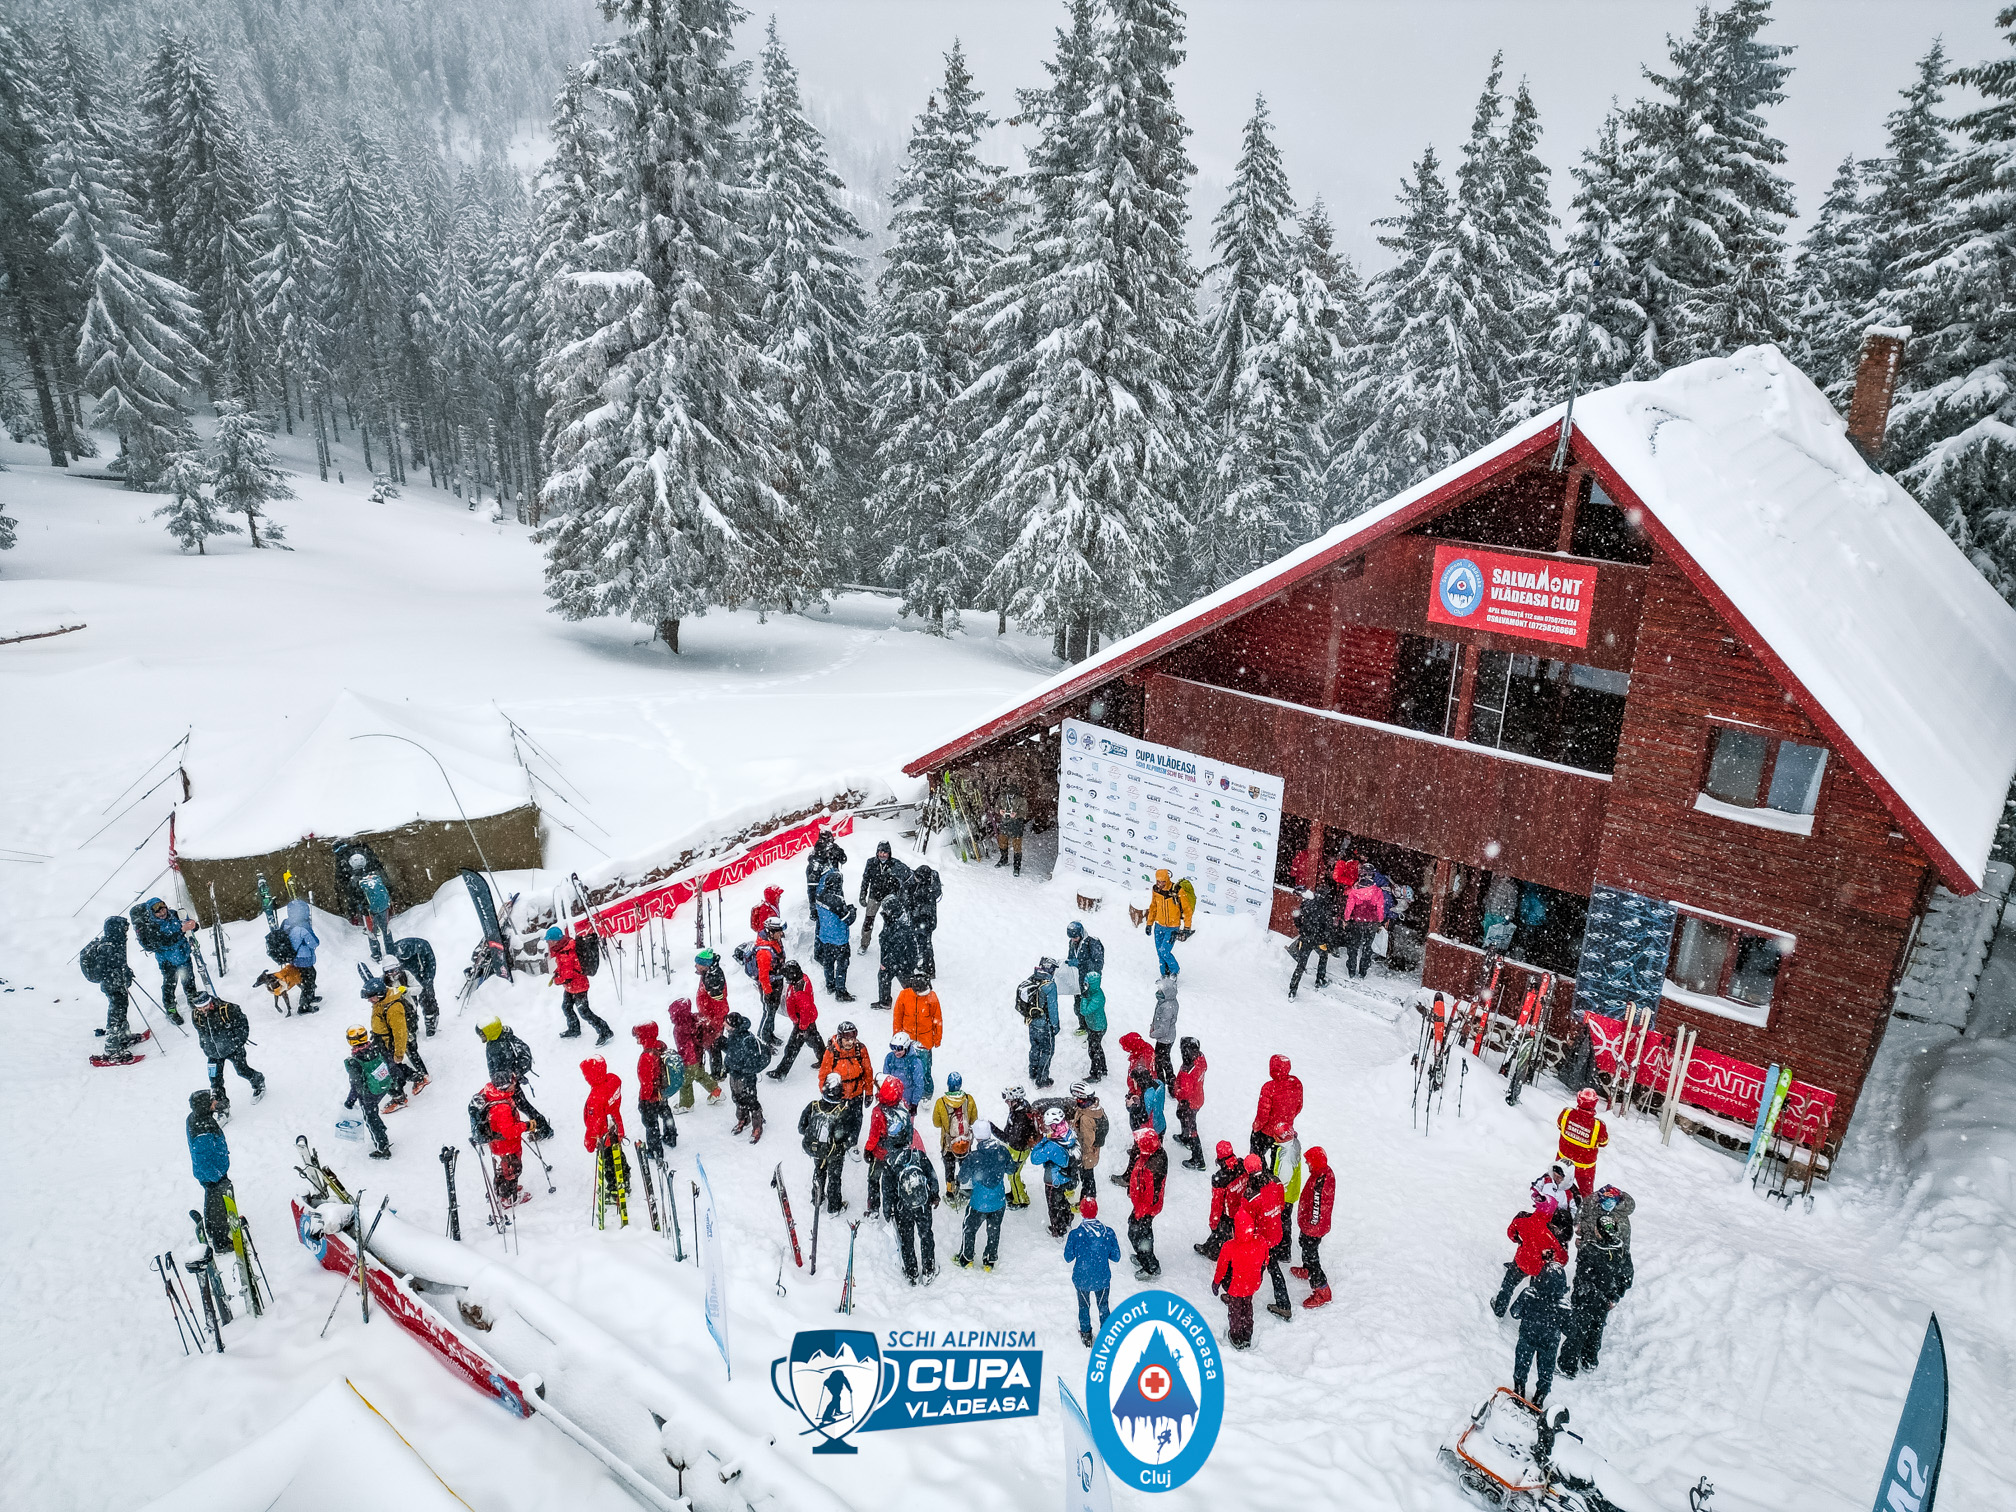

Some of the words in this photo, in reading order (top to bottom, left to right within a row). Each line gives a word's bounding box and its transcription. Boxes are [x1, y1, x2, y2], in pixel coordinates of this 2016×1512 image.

[1492, 565, 1584, 596] SALVAMONT
[1490, 586, 1549, 608] VLĂDEASA
[1550, 595, 1580, 613] CLUJ
[1524, 612, 1534, 620] 112
[1135, 748, 1156, 765] CUPA
[1156, 754, 1197, 776] VLĂDEASA
[719, 832, 814, 887] MONTURA
[1567, 1125, 1590, 1139] SMURD
